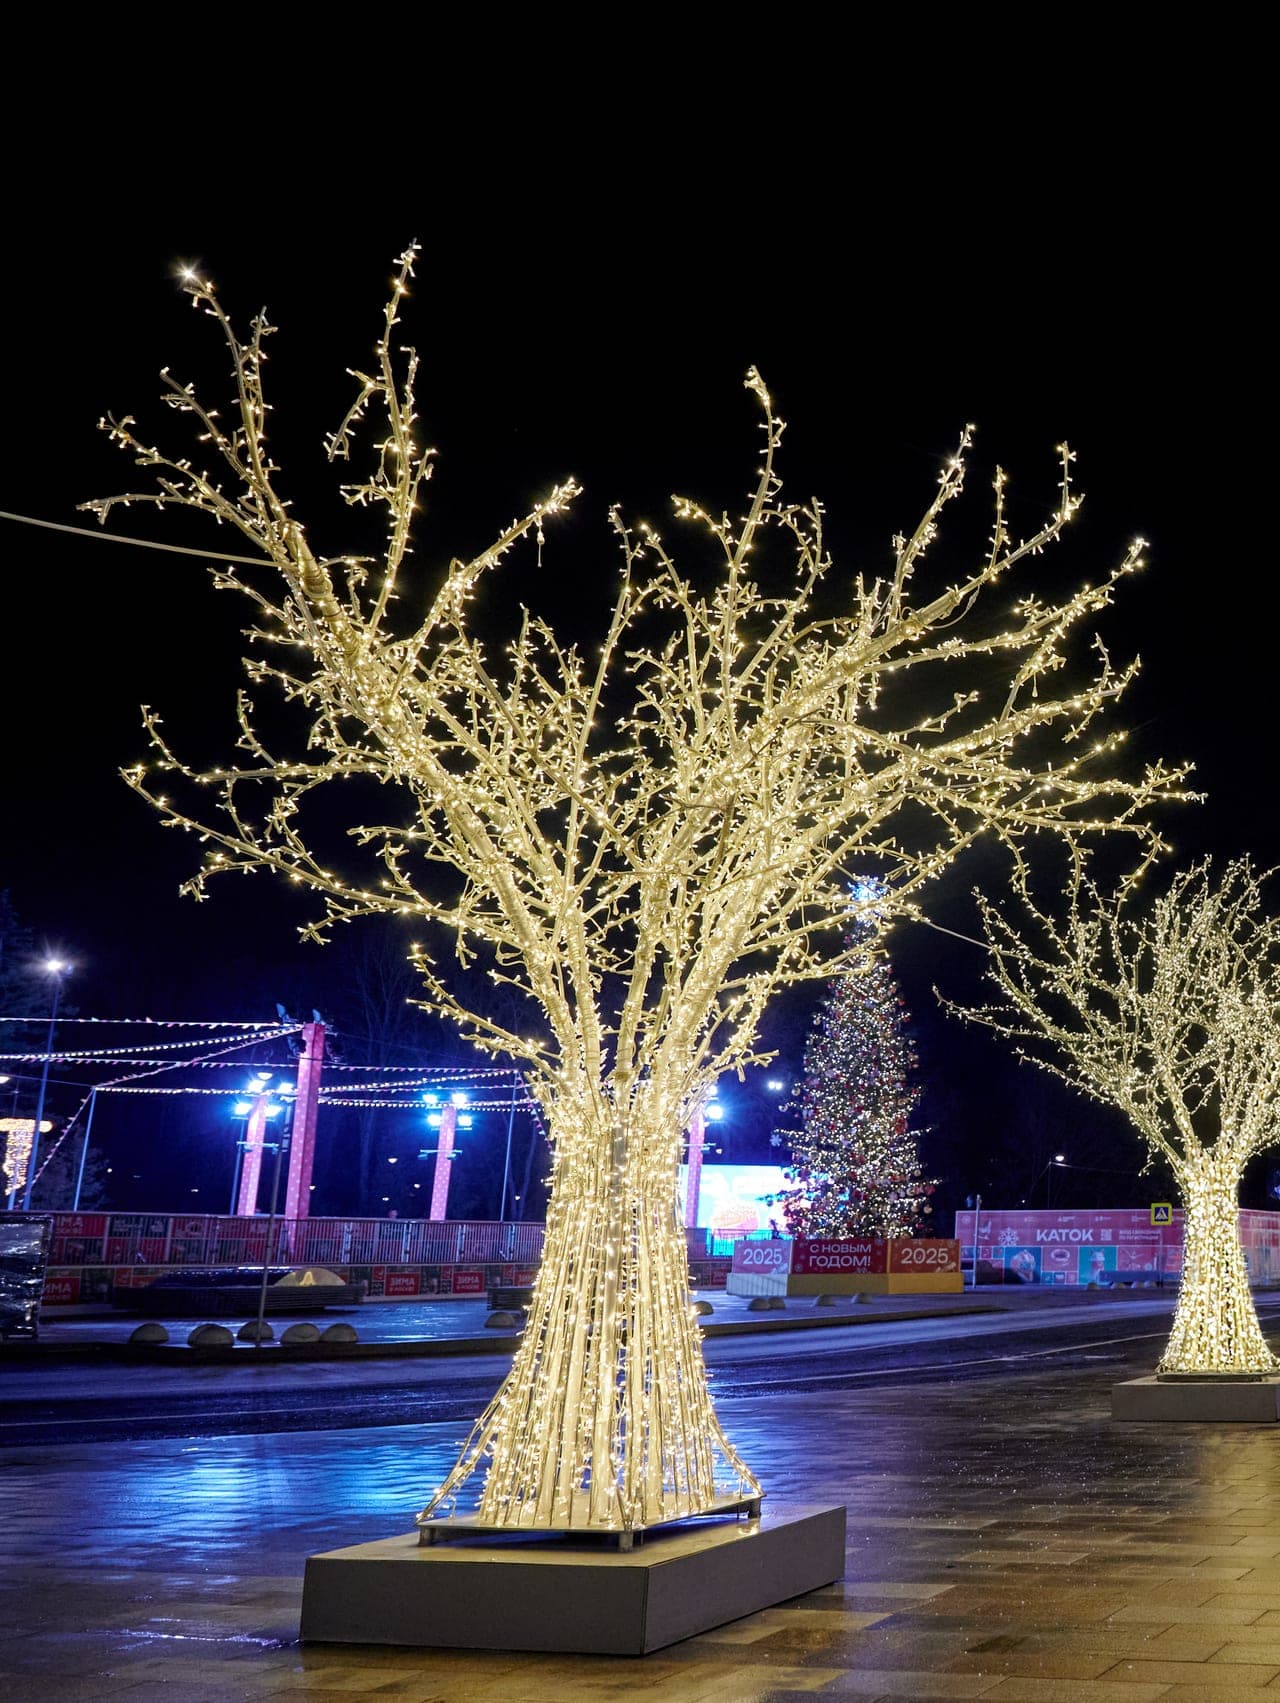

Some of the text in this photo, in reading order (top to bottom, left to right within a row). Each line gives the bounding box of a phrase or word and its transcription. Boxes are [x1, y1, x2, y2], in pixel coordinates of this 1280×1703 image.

[1036, 1229, 1094, 1242] КАТОК
[809, 1243, 872, 1252] С НОВЫМ
[743, 1248, 783, 1265] 2025
[809, 1255, 871, 1268] ГОДОМ!
[901, 1247, 949, 1264] 2025
[391, 1277, 415, 1286] ЗИМА
